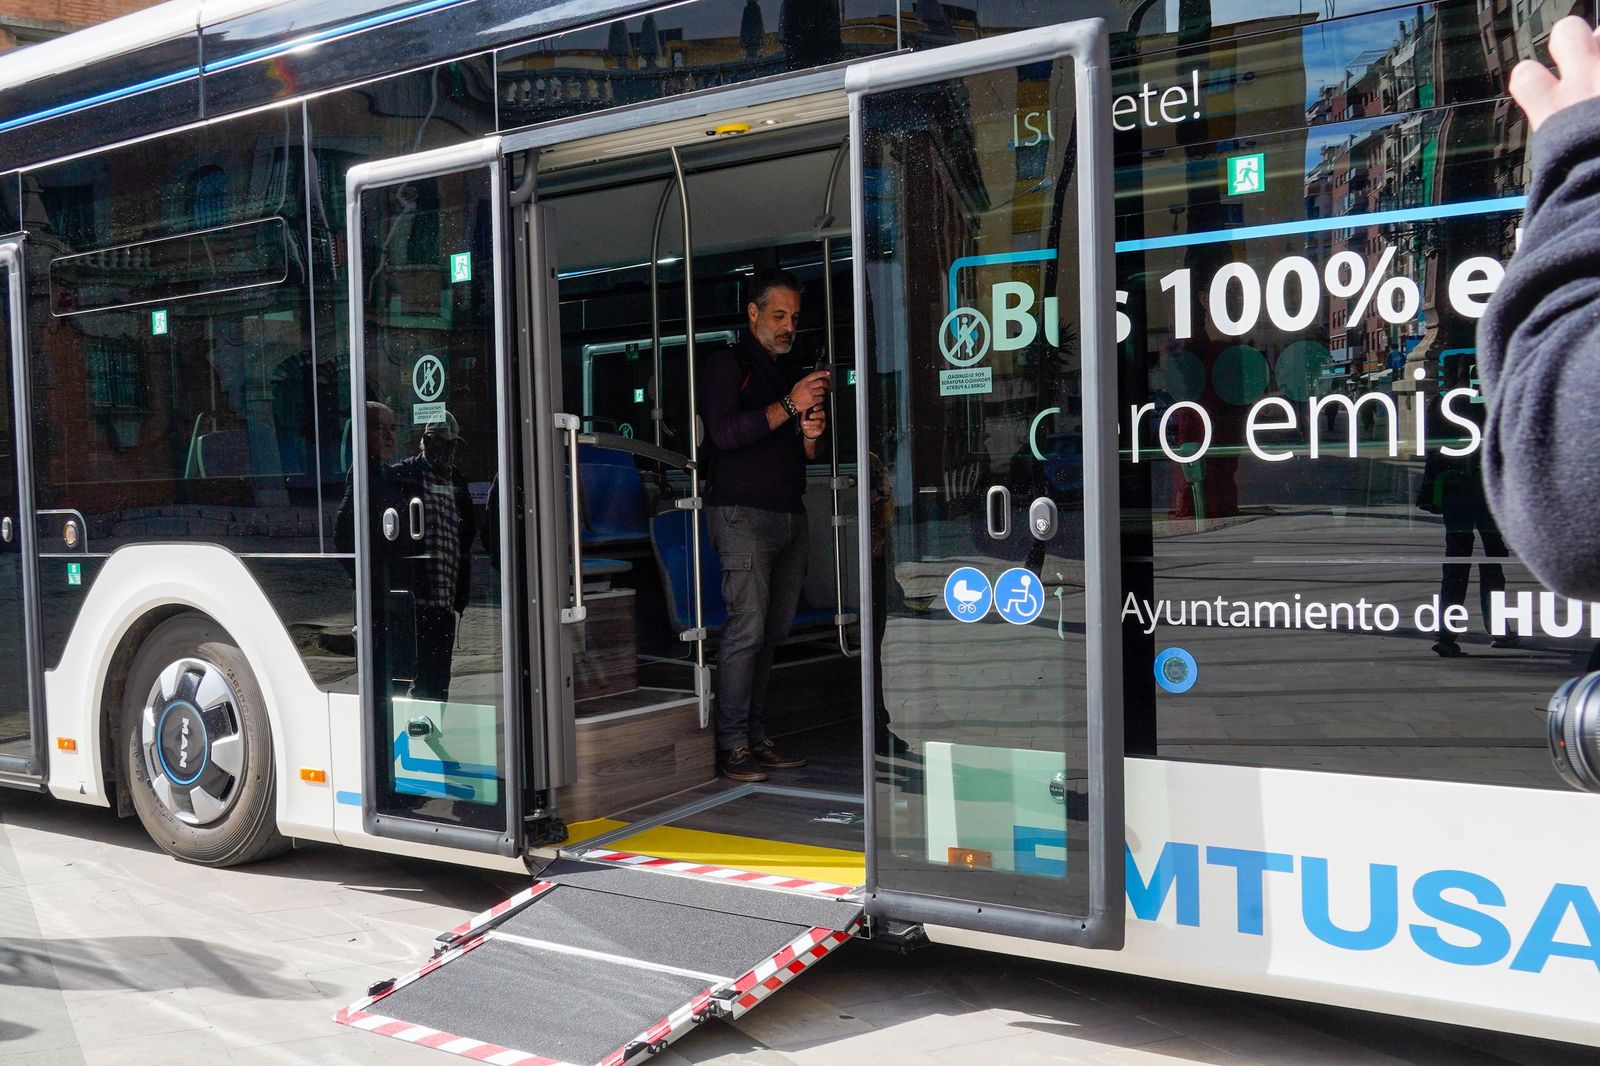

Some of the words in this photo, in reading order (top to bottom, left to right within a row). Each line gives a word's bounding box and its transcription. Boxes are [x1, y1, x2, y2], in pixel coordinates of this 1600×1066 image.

[1159, 246, 1420, 340] 100%
[1246, 368, 1481, 461] emis
[1121, 591, 1400, 634] Ayuntamiento
[1414, 594, 1469, 633] de
[1491, 591, 1600, 638] HU
[179, 717, 190, 769] MAN
